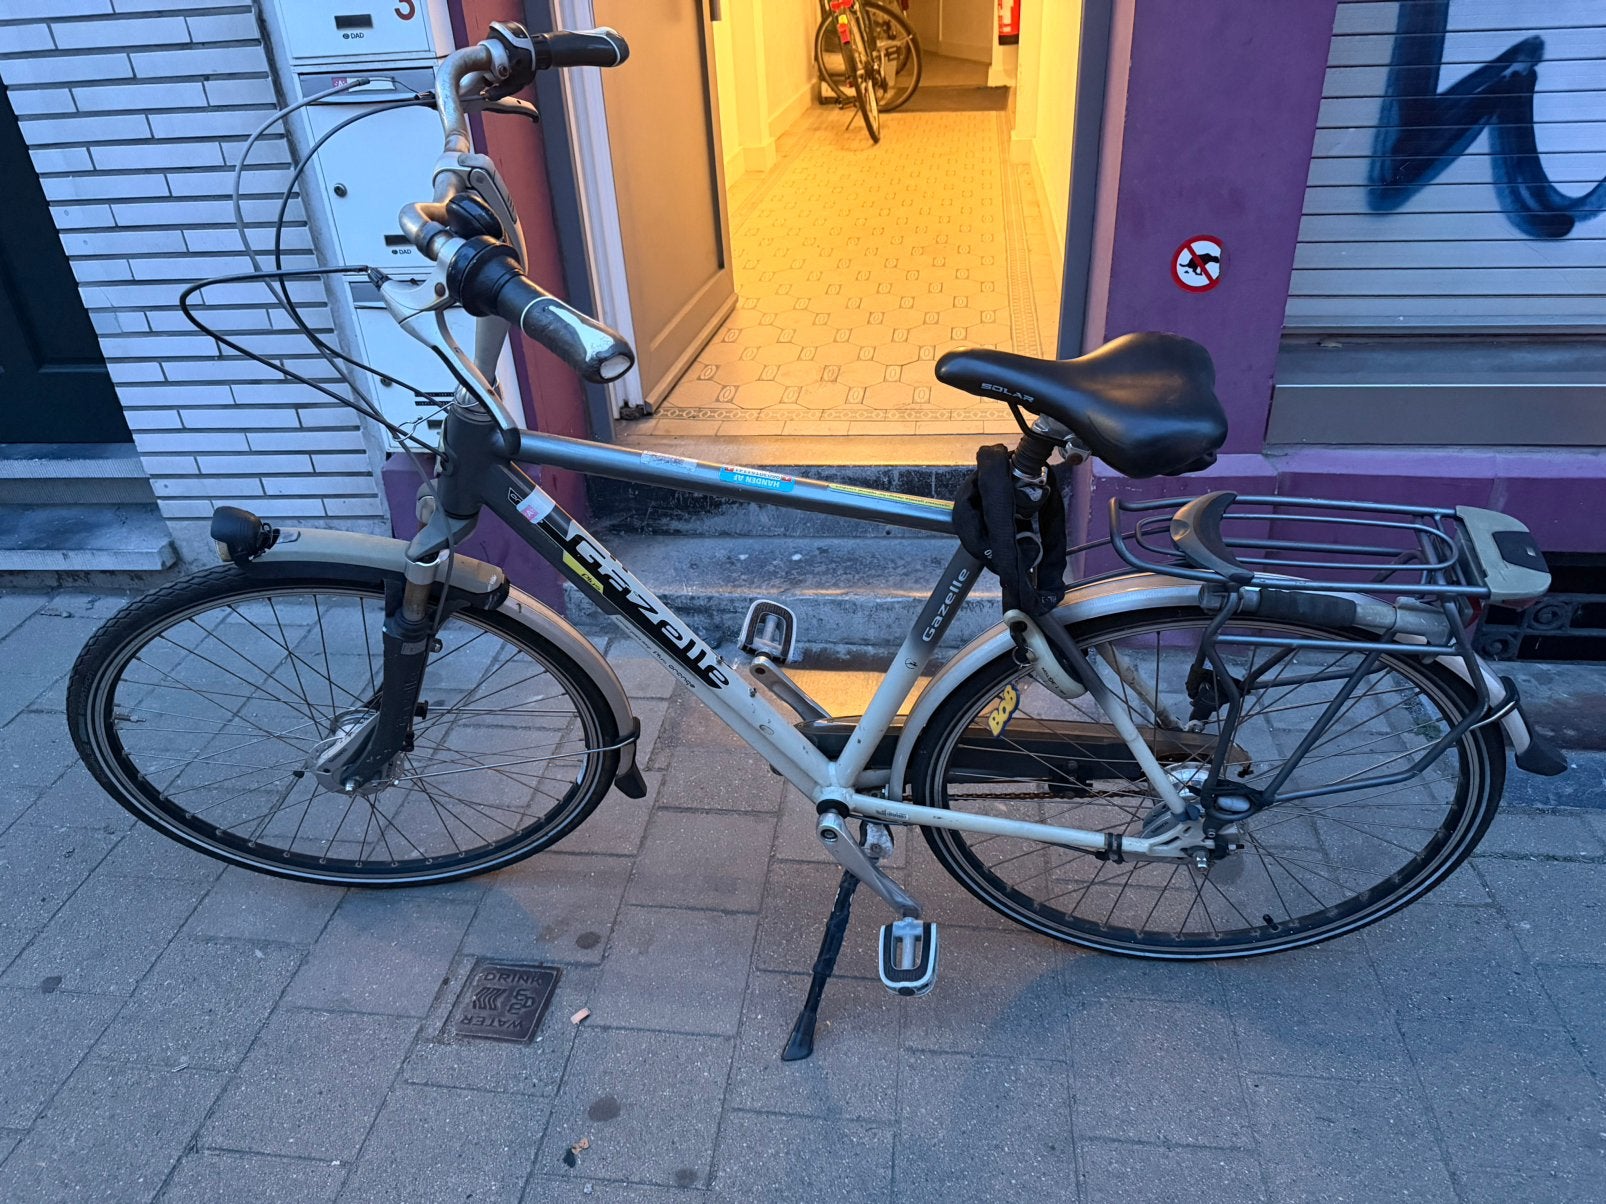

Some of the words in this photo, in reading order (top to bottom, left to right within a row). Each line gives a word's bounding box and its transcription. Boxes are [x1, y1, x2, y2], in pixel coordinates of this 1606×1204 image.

[980, 382, 1035, 403] SOLAR
[745, 475, 781, 488] HANDEN
[922, 568, 970, 642] Gazelle
[483, 971, 544, 986] DRINK
[459, 1015, 523, 1030] WATER
